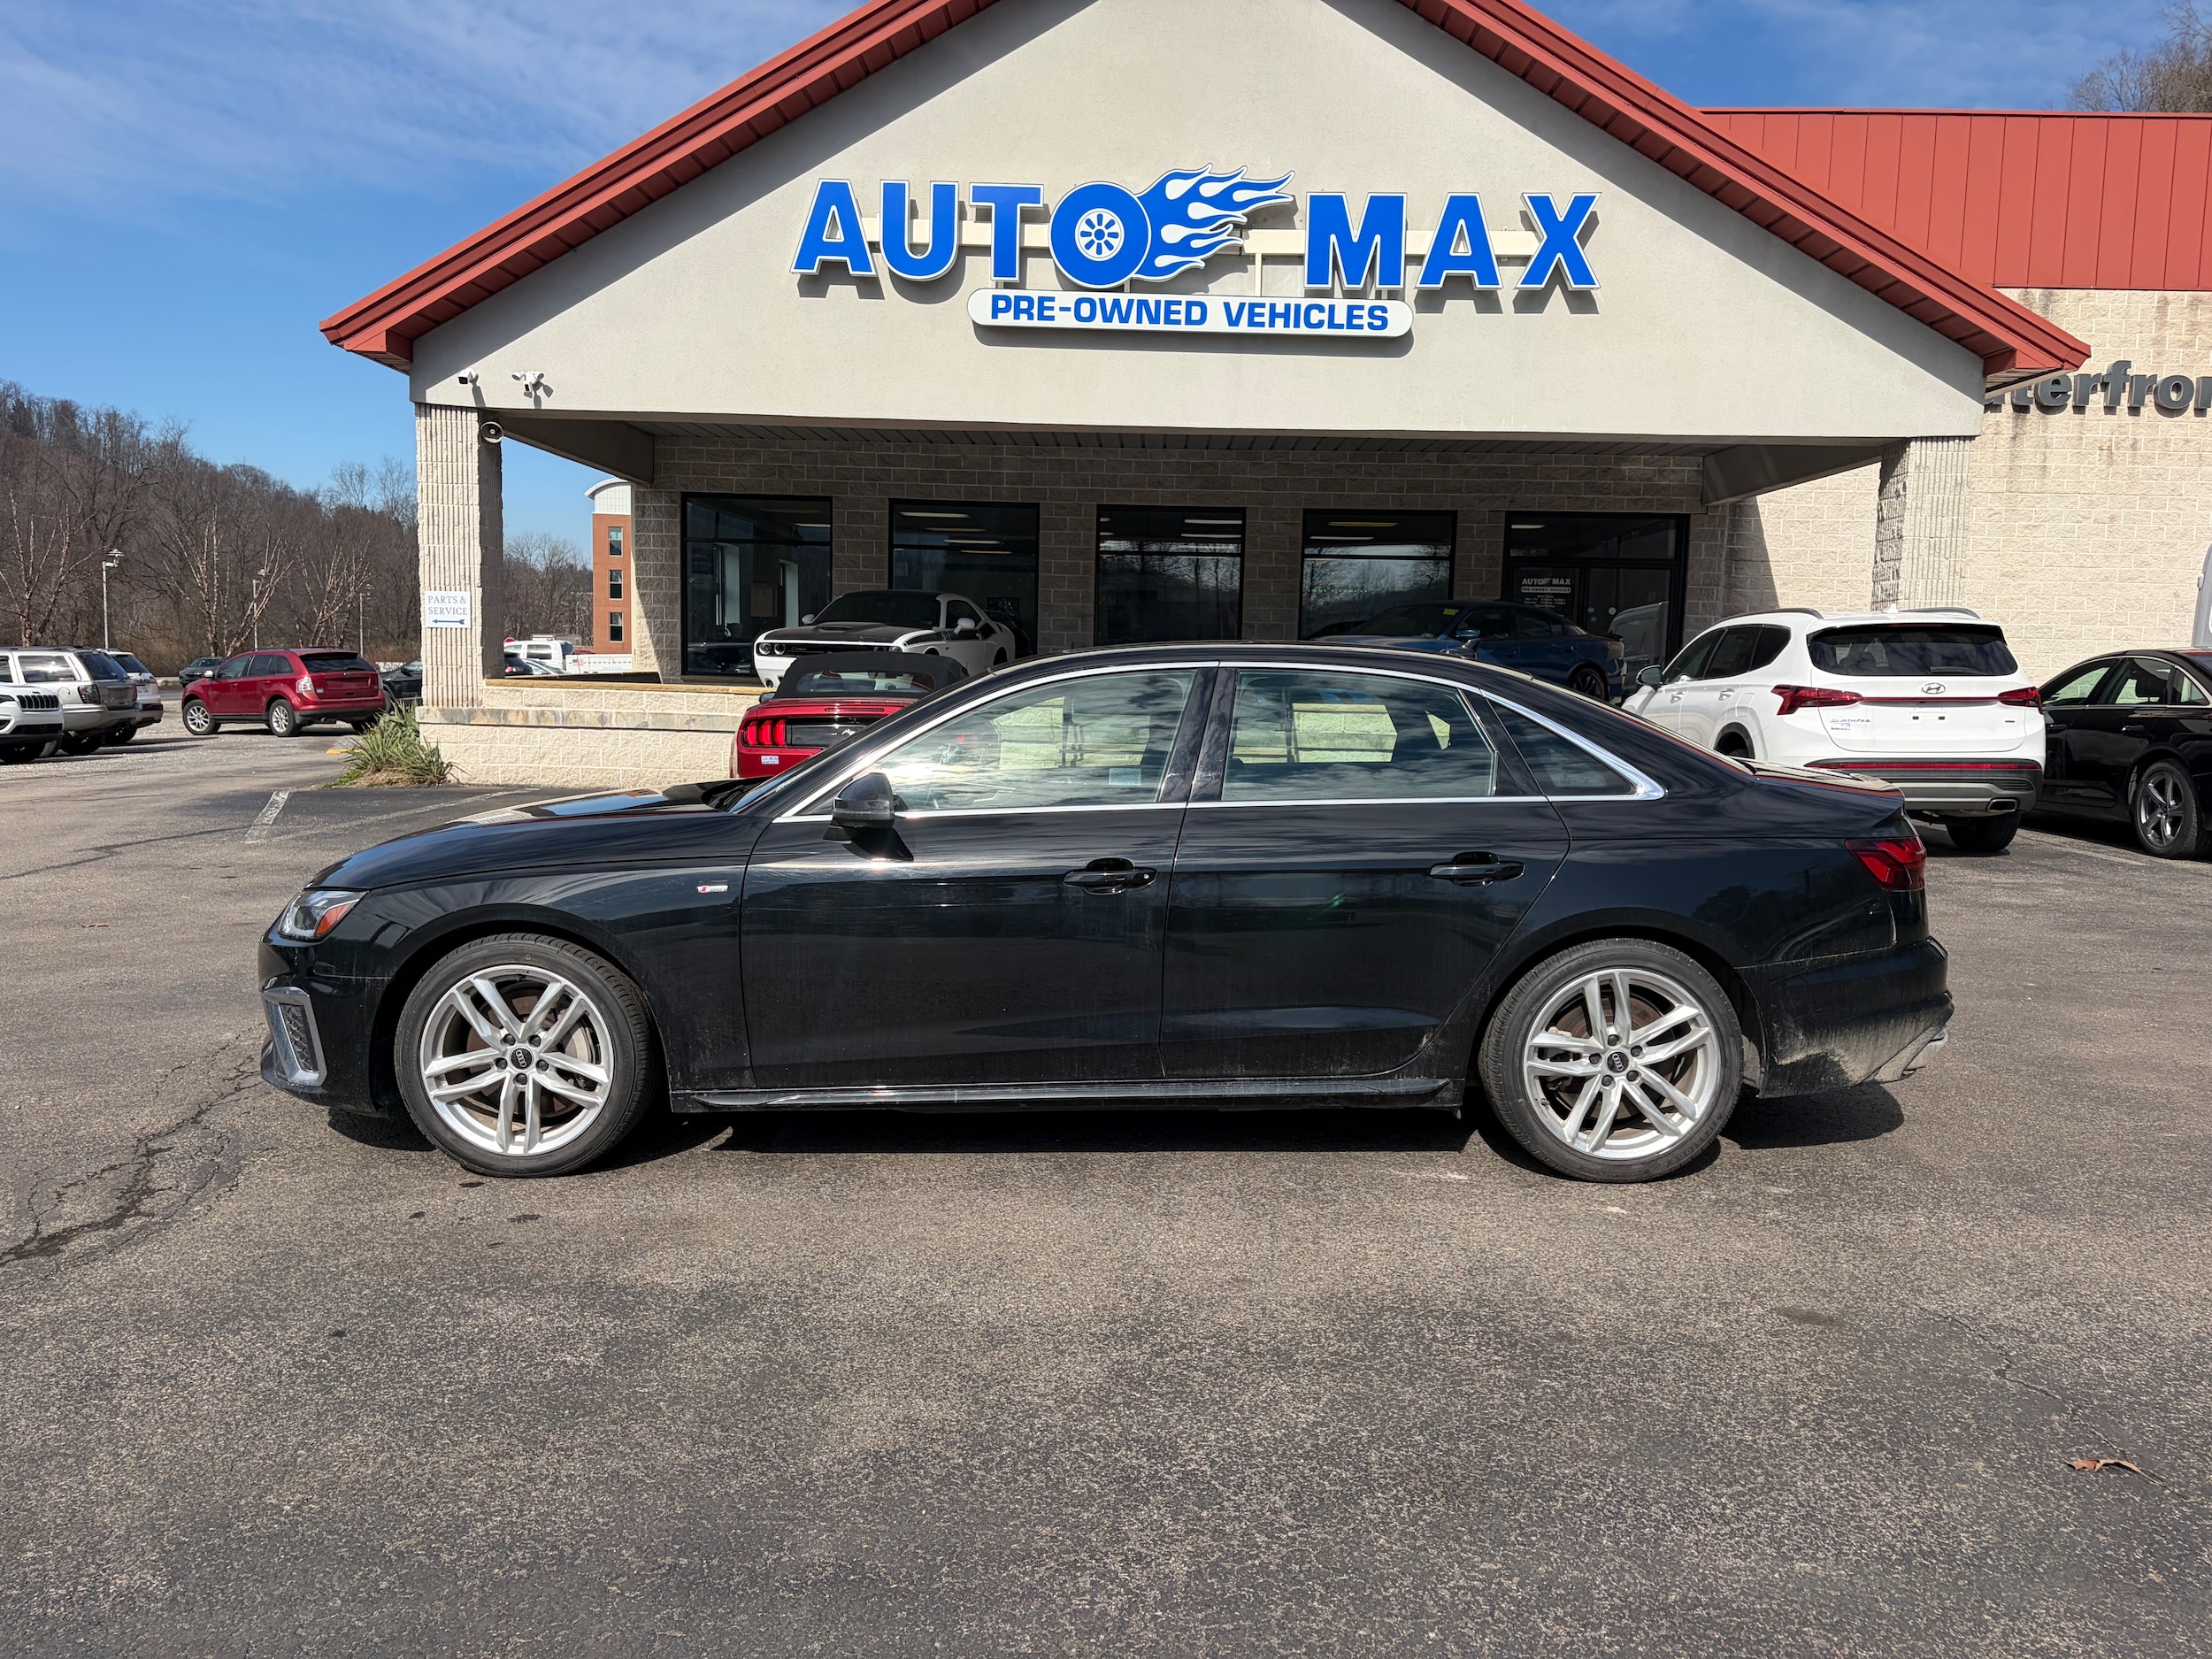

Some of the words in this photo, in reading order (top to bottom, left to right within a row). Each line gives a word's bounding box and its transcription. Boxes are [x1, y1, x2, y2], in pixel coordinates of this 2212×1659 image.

[790, 179, 1152, 289] AUTO
[1303, 192, 1602, 290] MAX
[990, 294, 1209, 326] PRE-OWNED
[1223, 302, 1389, 331] VEHICLES
[427, 595, 458, 604] PARTS
[459, 595, 467, 604] &
[427, 606, 468, 616] SERVICE
